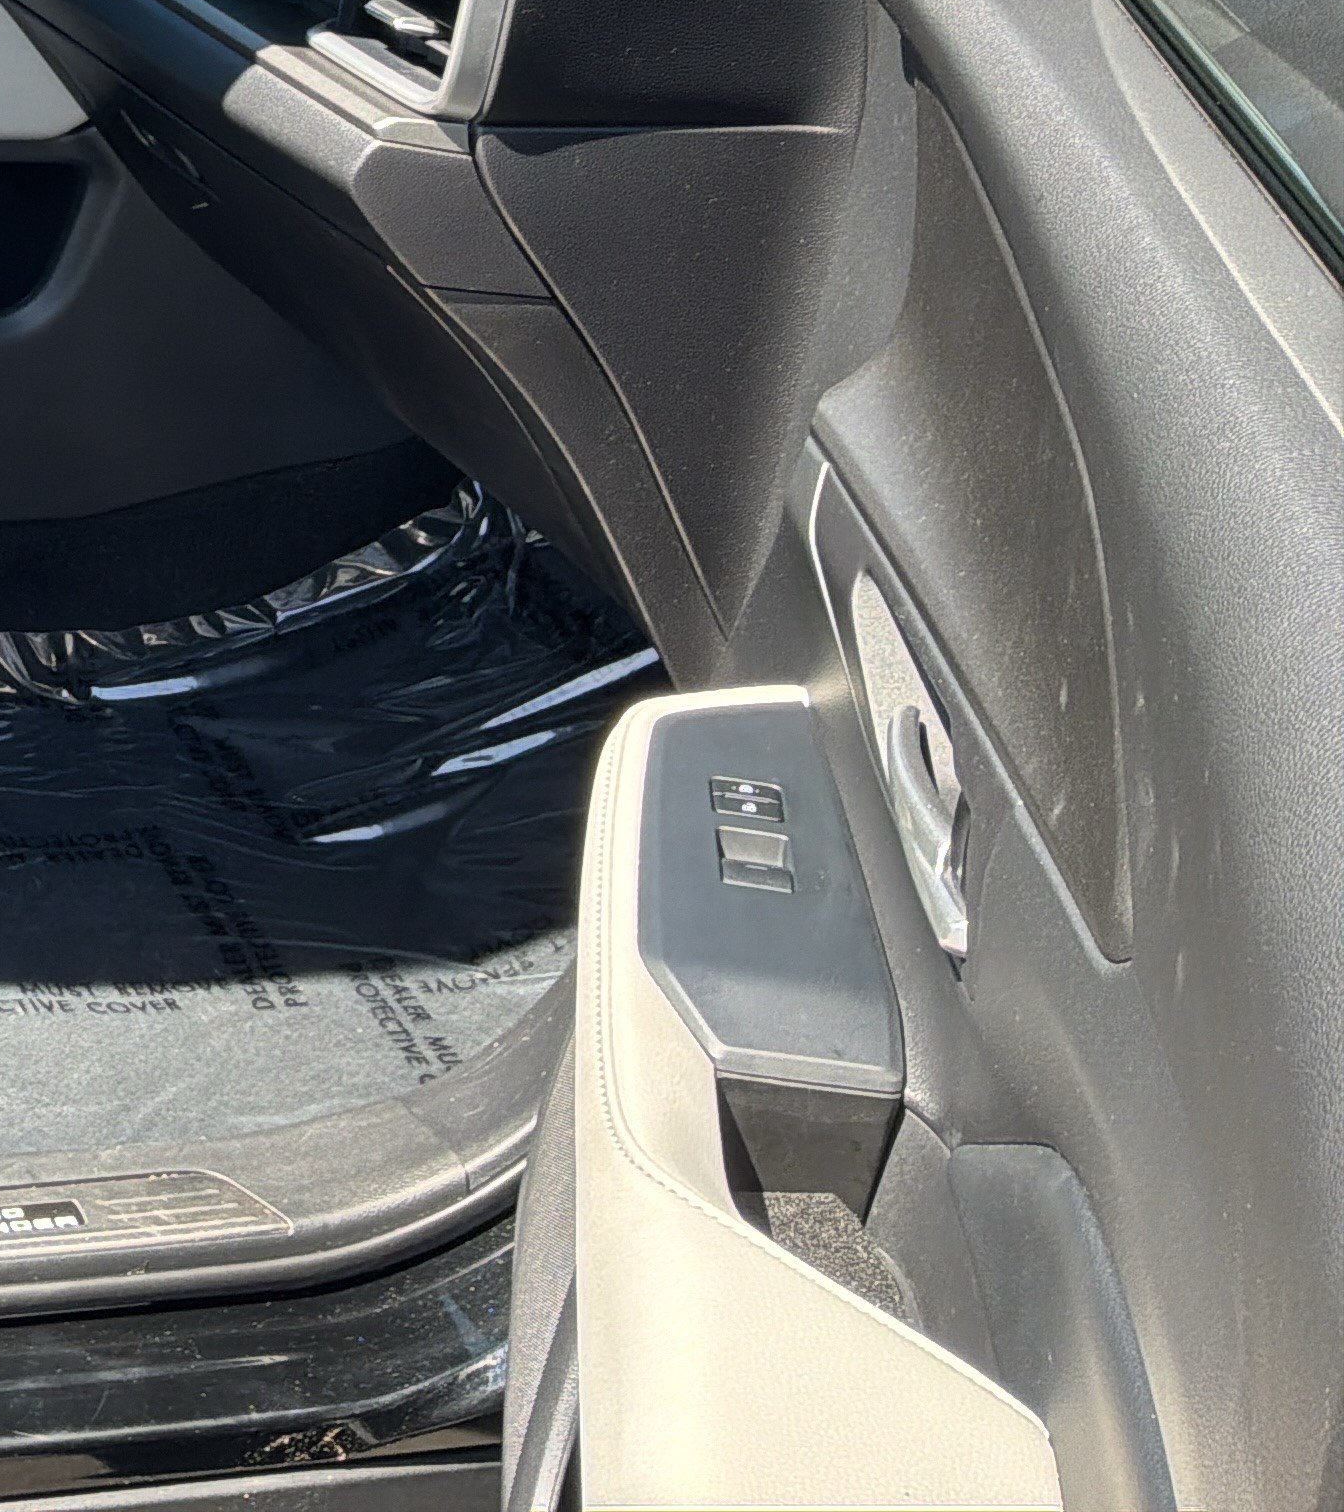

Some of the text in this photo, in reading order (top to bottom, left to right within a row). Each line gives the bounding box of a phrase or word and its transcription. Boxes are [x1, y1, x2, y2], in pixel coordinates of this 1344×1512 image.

[20, 982, 95, 997] MUST
[85, 998, 182, 1014] COVER
[364, 955, 464, 1072] DEALER MU
